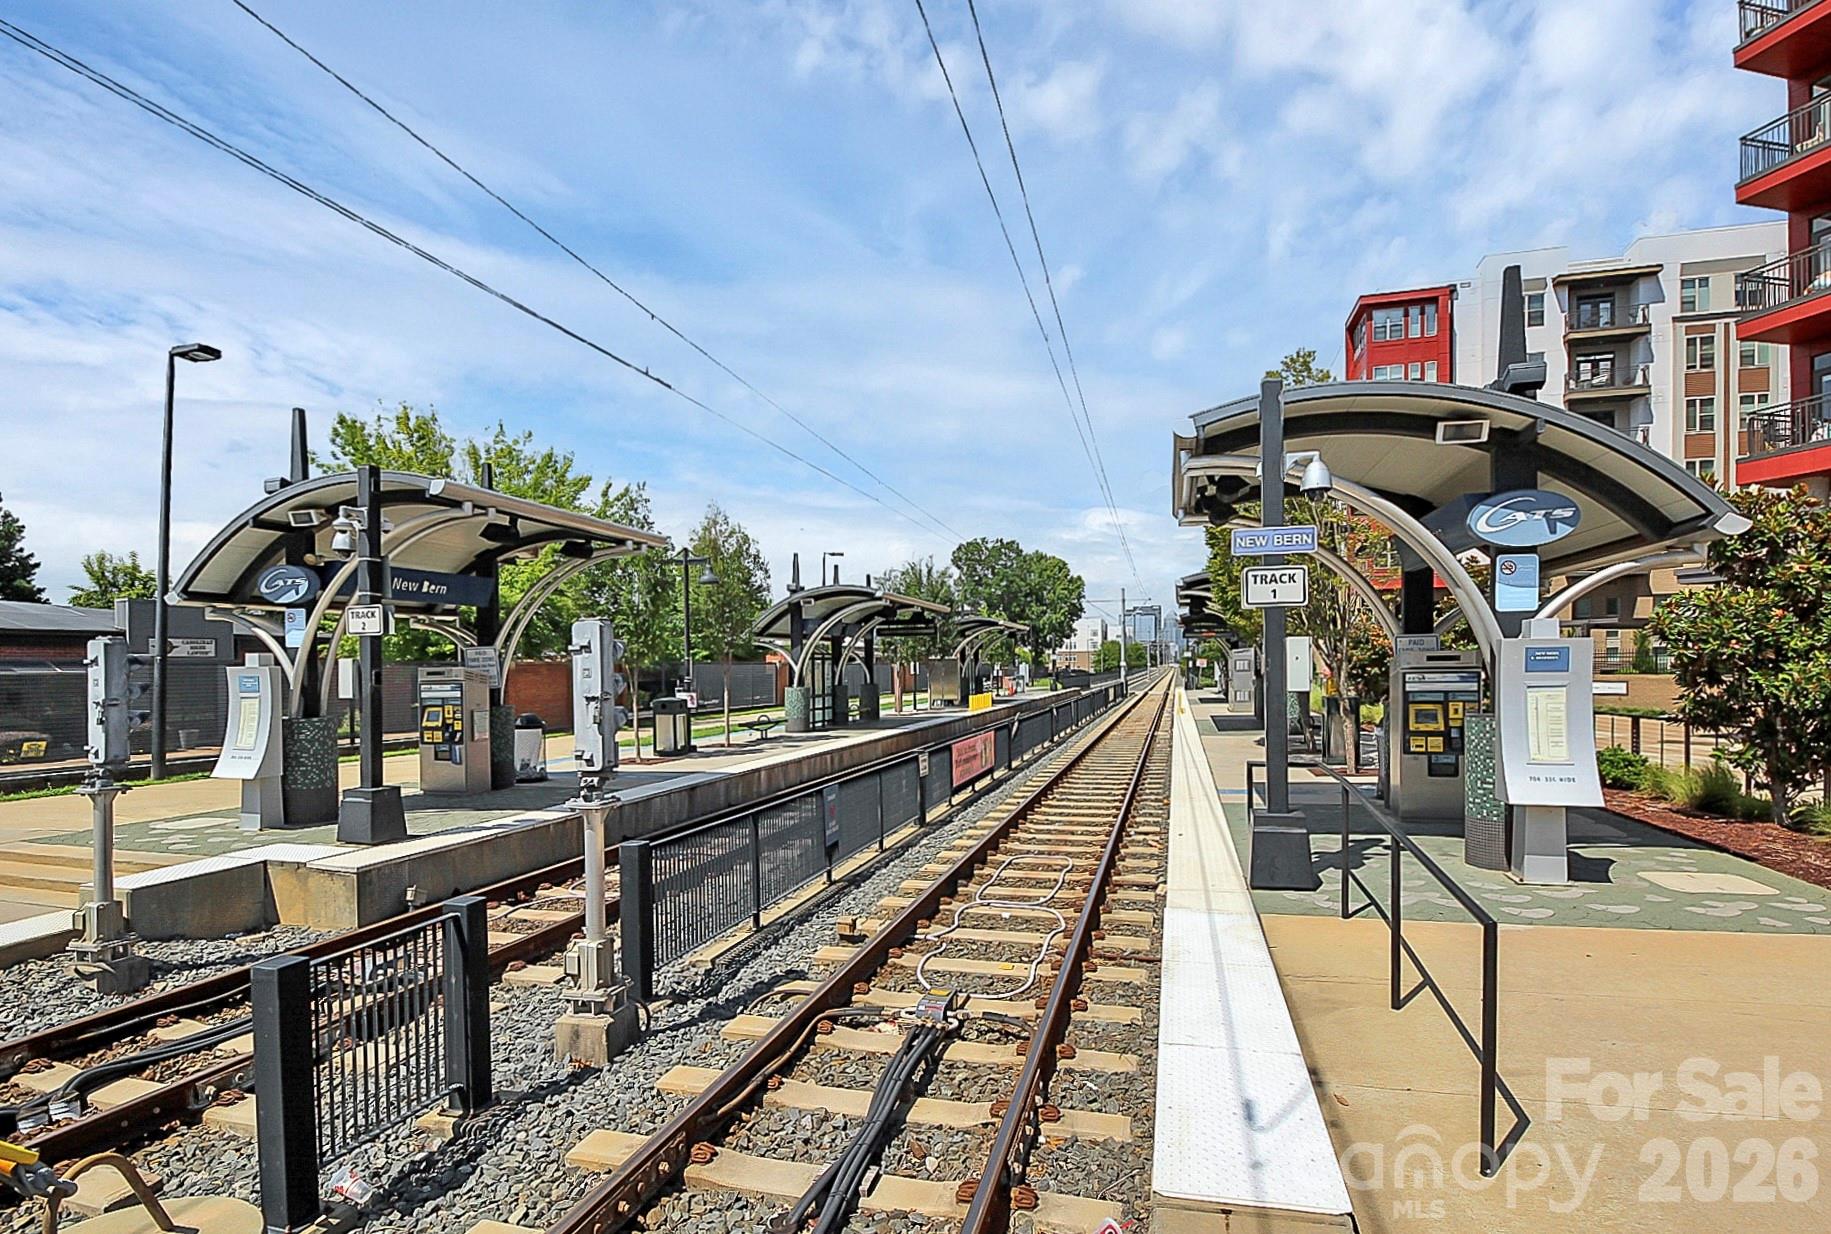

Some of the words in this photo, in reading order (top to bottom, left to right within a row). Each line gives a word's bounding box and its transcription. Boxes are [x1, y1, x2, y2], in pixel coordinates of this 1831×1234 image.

[1476, 496, 1577, 533] CATS
[1236, 535, 1268, 548] NEW
[1273, 533, 1312, 546] BERN
[1251, 572, 1297, 585] TRACK
[392, 577, 419, 592] New
[422, 580, 448, 595] Bern
[1270, 588, 1277, 599] 1
[350, 609, 377, 619] TRACK
[361, 622, 366, 631] 2
